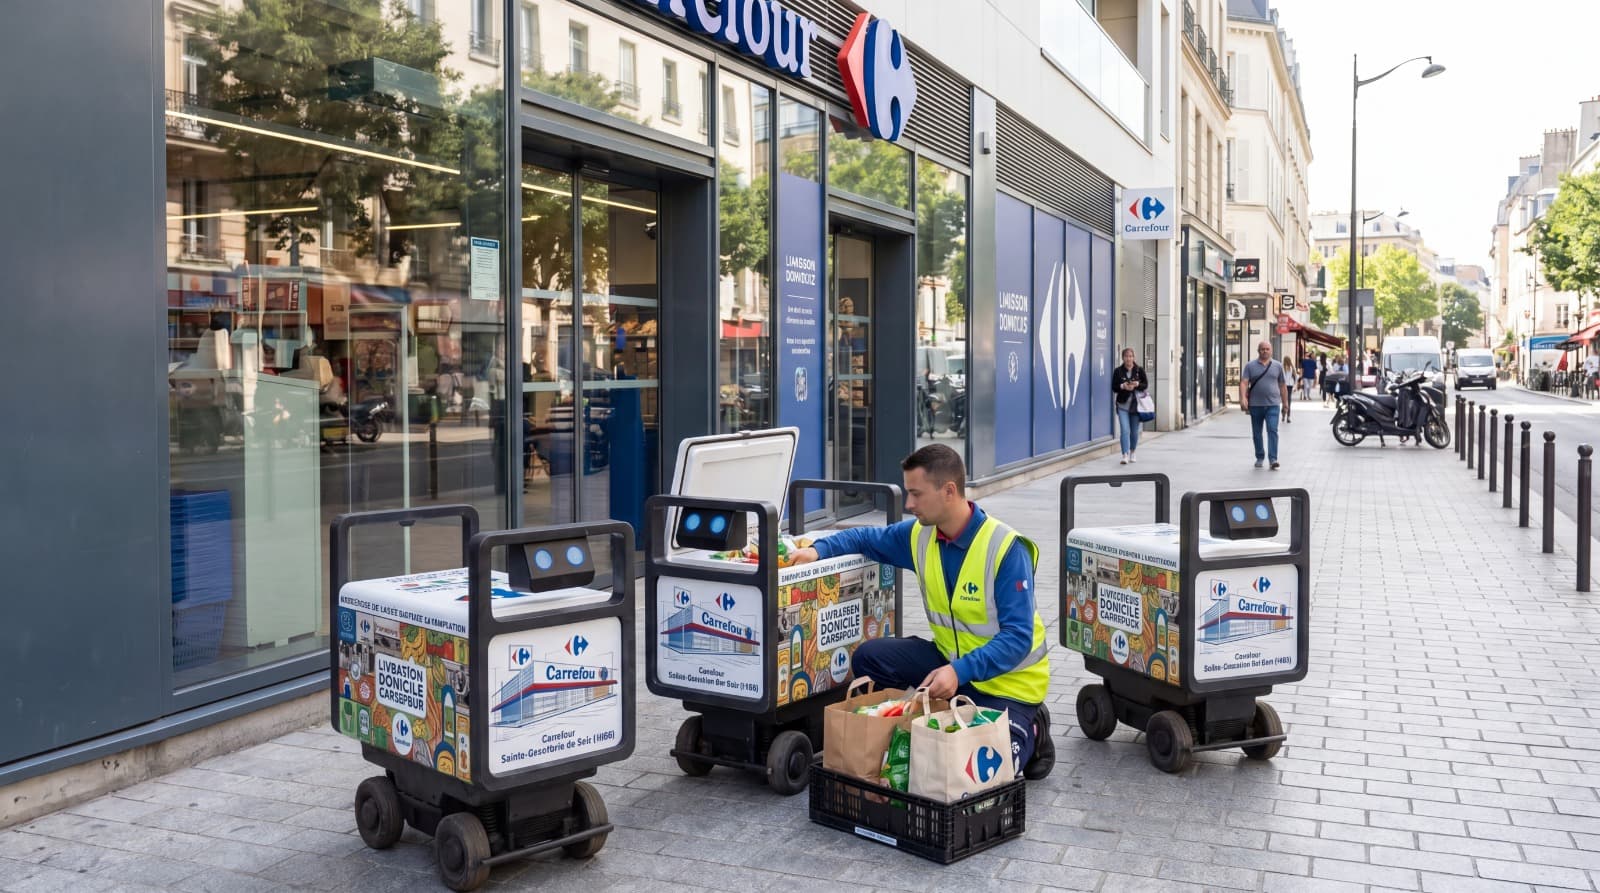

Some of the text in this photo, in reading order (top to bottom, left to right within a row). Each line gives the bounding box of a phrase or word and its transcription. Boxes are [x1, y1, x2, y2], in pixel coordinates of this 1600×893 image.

[668, 0, 818, 78] efour
[1125, 223, 1169, 232] Carrefour
[1100, 597, 1140, 619] DONICILE
[1238, 598, 1278, 614] Carrefour
[821, 614, 860, 635] DONICILE
[378, 672, 424, 698] DONICILE
[566, 740, 576, 750] de
